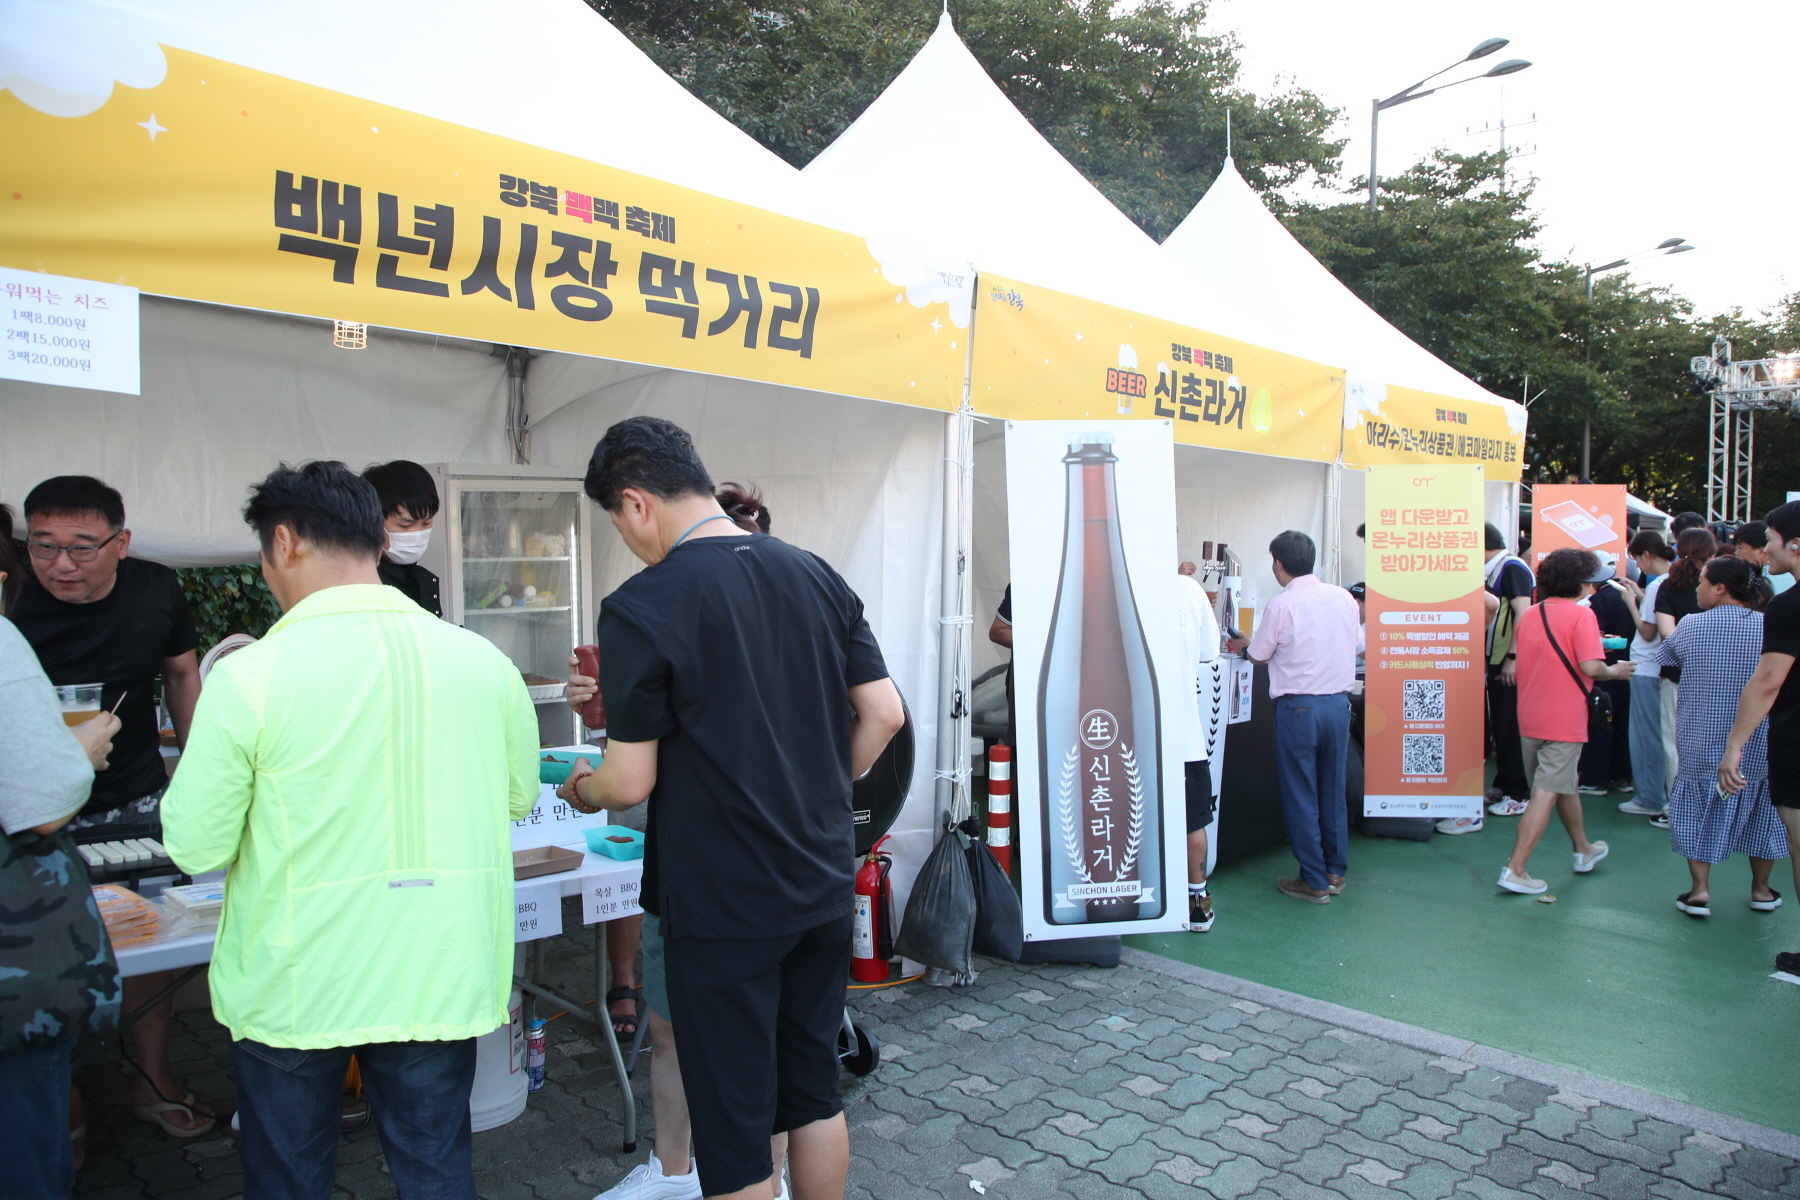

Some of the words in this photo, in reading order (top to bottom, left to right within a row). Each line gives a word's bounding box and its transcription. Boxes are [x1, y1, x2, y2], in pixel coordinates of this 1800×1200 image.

[499, 173, 558, 216] 강북
[565, 190, 620, 231] 백맥
[625, 205, 676, 245] 축제
[274, 169, 619, 323] 백년시장
[638, 251, 821, 360] 먹거리
[73, 293, 110, 311] 치즈
[1171, 343, 1192, 364] 강북
[1214, 353, 1233, 374] 축제
[1106, 367, 1147, 398] BEER
[1154, 369, 1247, 430] 신촌라거
[1503, 441, 1517, 462] 홍보
[1380, 508, 1397, 526] 앱
[1401, 508, 1470, 526] 다운받고
[1371, 531, 1479, 549] 온누리상품권
[1380, 554, 1469, 572] 받아가세요
[1405, 613, 1443, 622] EVENT
[1389, 632, 1405, 640] 10%
[1452, 646, 1469, 655] 50%
[1087, 716, 1111, 741] 生
[1088, 754, 1115, 872] 신촌라거
[620, 882, 638, 893] BBQ
[1071, 884, 1108, 896] SINCHON
[1110, 883, 1138, 894] LAGER
[518, 902, 537, 914] BBQ
[595, 903, 618, 914] 1인분
[621, 898, 638, 910] 만원
[519, 918, 538, 931] 만원
